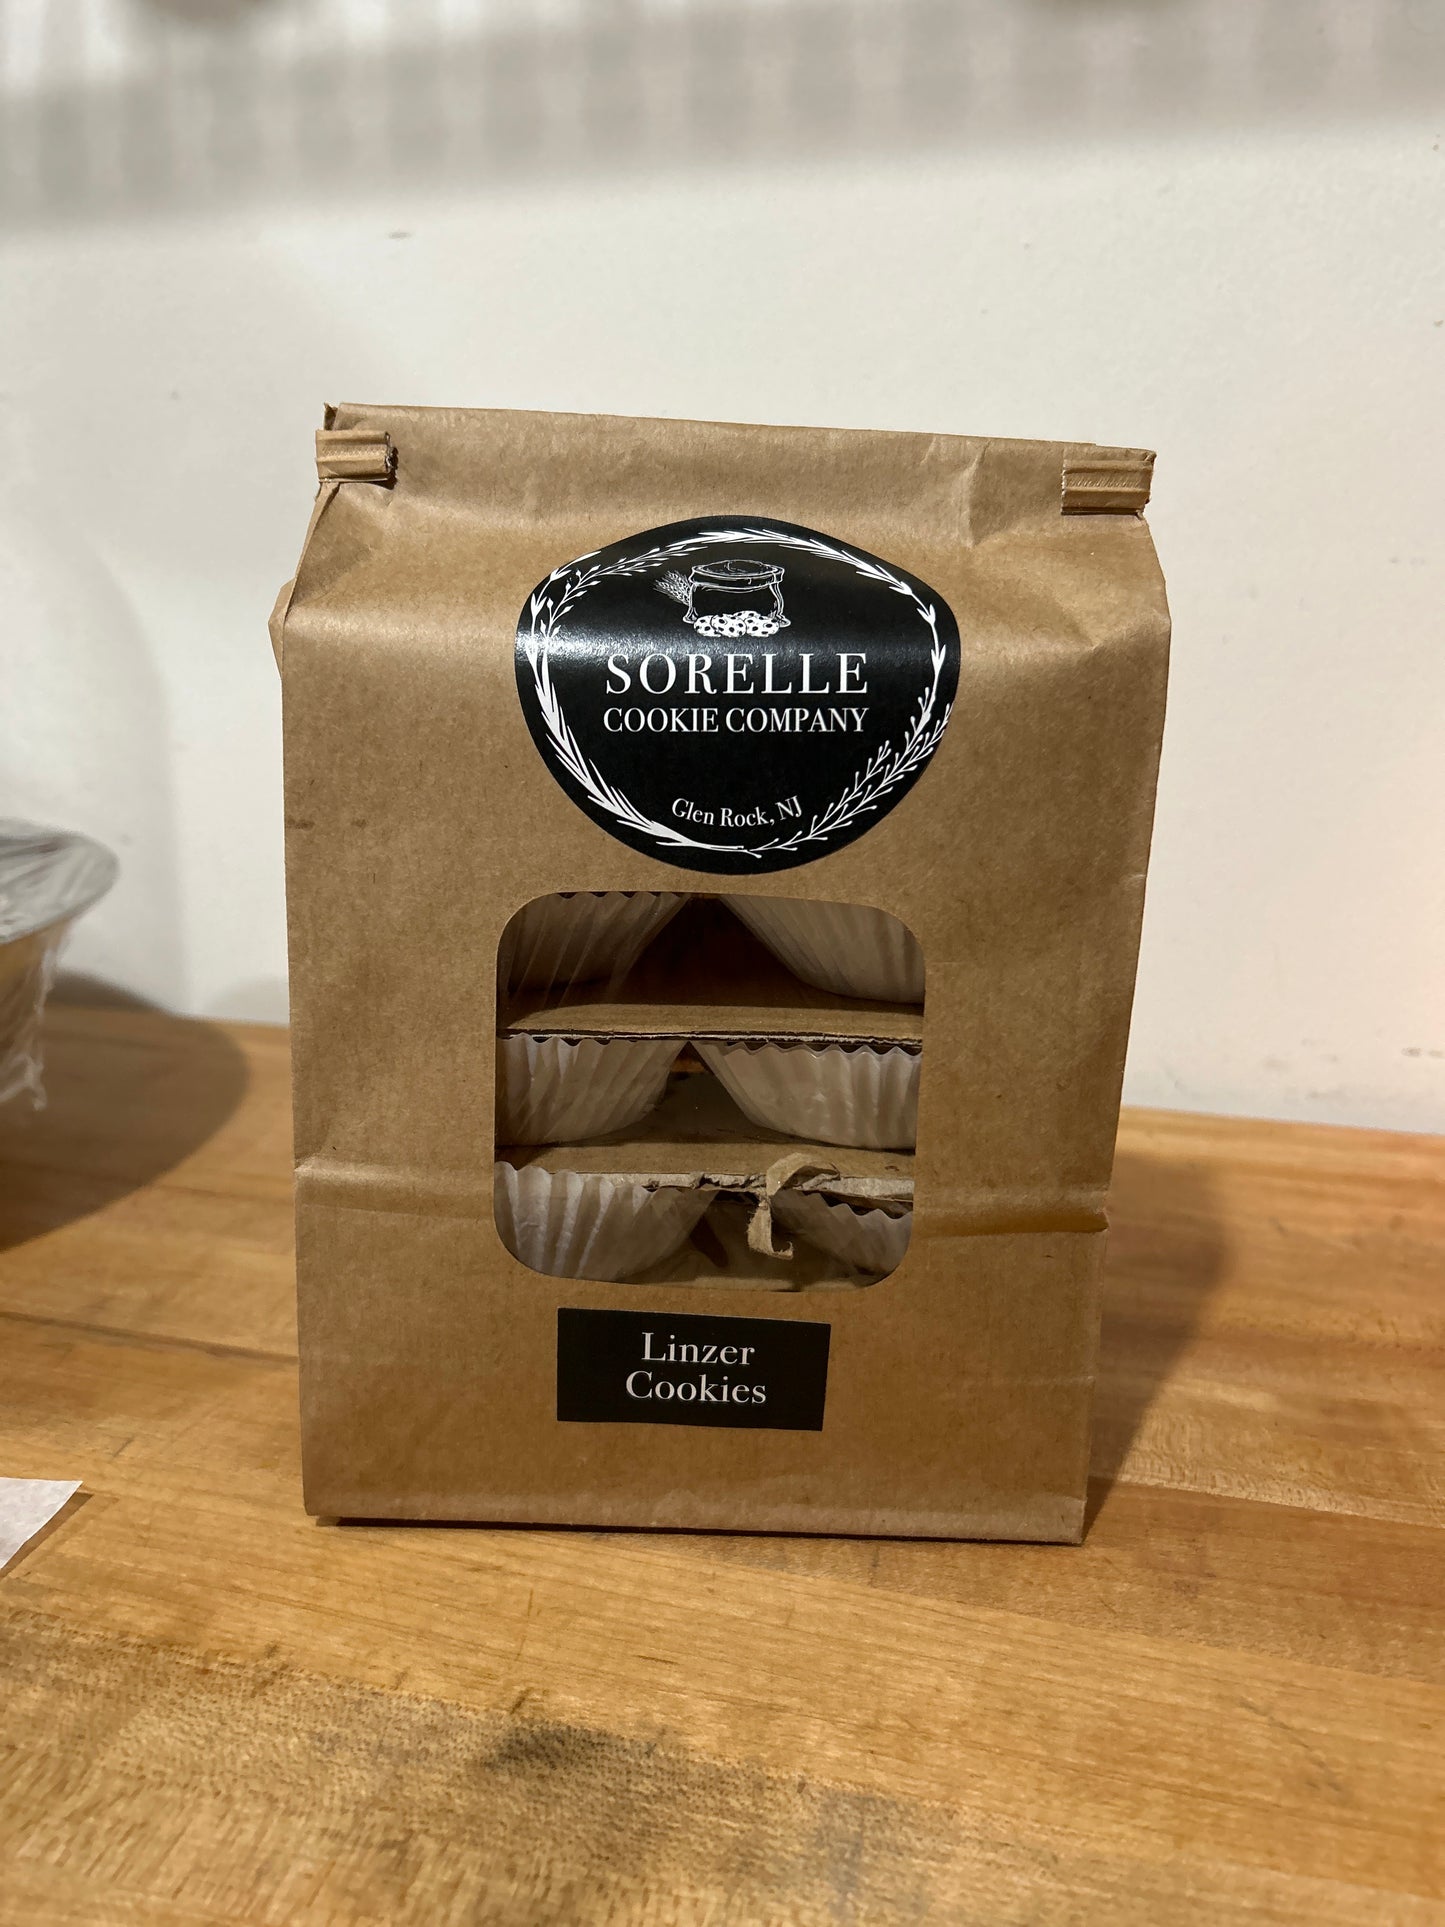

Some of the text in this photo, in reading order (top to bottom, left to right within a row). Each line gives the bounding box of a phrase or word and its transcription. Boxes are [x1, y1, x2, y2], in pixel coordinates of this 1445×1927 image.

[605, 652, 868, 695] SORELLE
[602, 707, 870, 733] COOKIE COMPANY
[671, 795, 803, 828] Glen Rock, NJ
[641, 1332, 755, 1365] Linzer
[625, 1370, 767, 1404] Cookies
